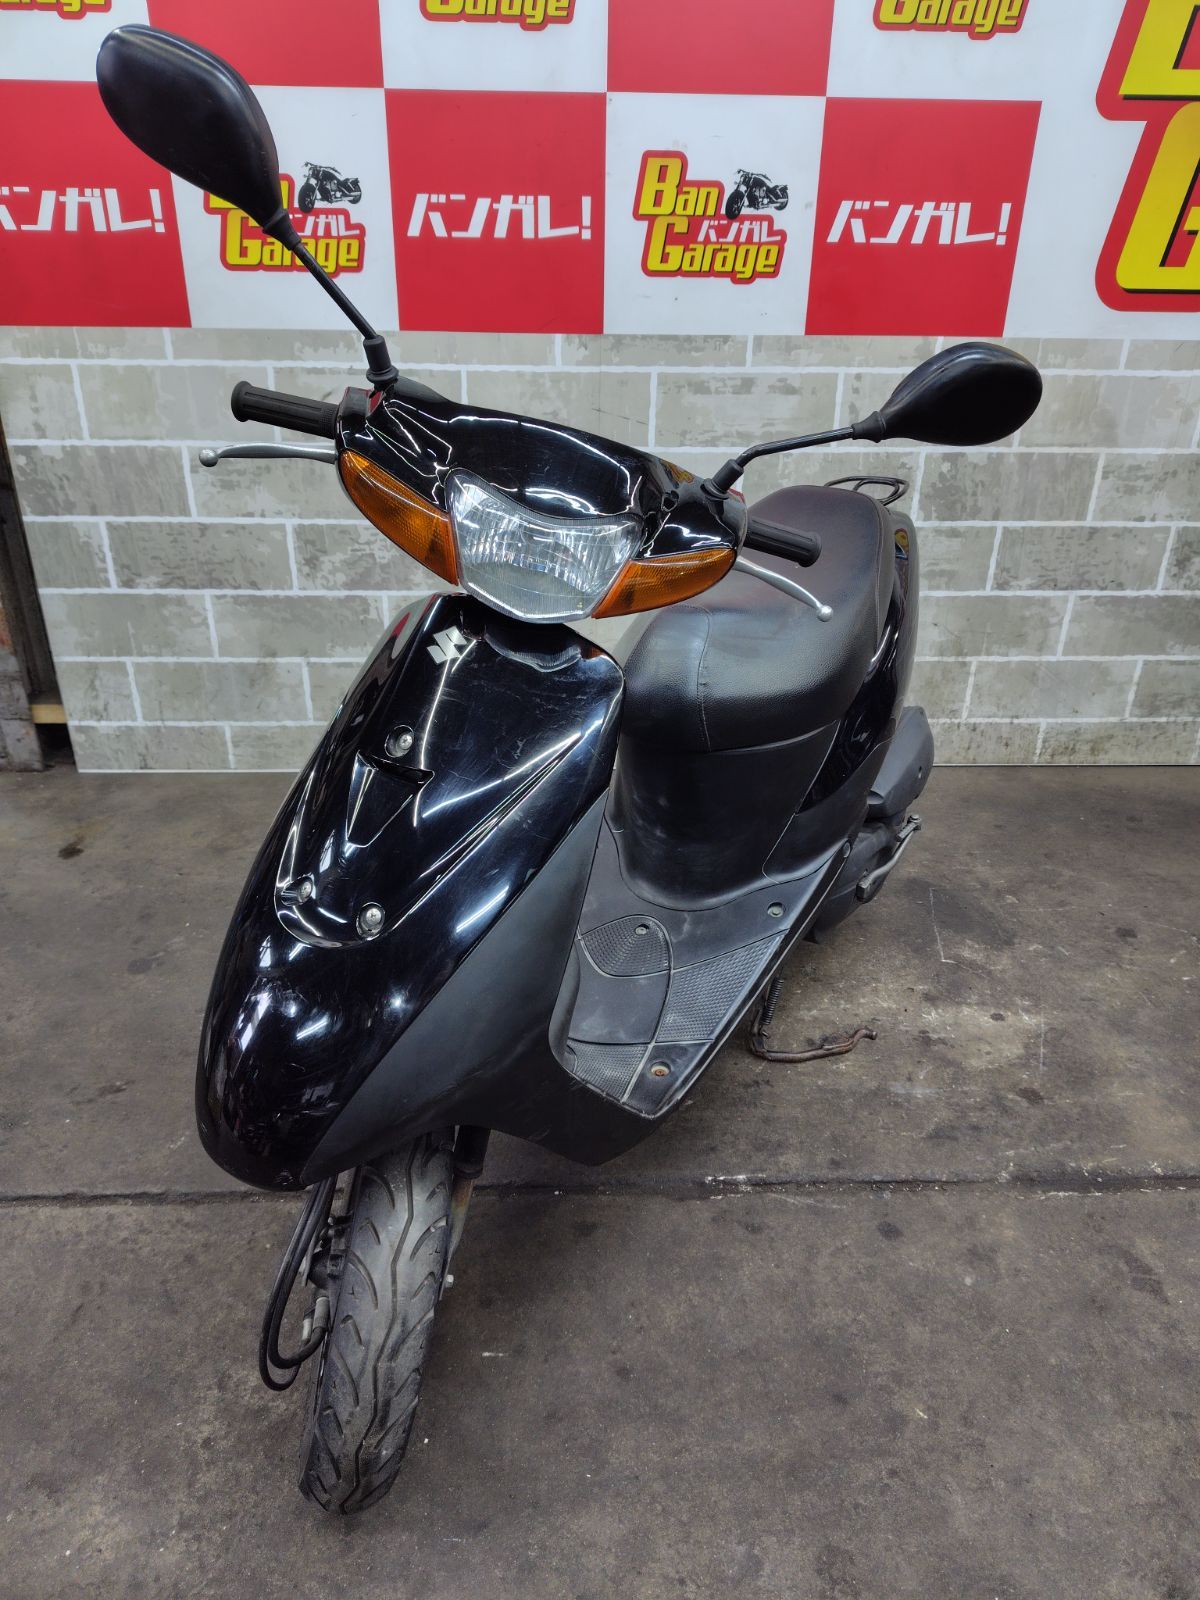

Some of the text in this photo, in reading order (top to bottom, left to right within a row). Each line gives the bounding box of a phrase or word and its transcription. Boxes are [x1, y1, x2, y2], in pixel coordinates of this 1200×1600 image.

[638, 157, 720, 217] Ban
[289, 214, 360, 237] ンガレ
[406, 193, 592, 240] バンガレ!
[697, 219, 782, 243] バンガレ
[826, 200, 1012, 245] バンガレ!
[647, 216, 780, 279] Garage
